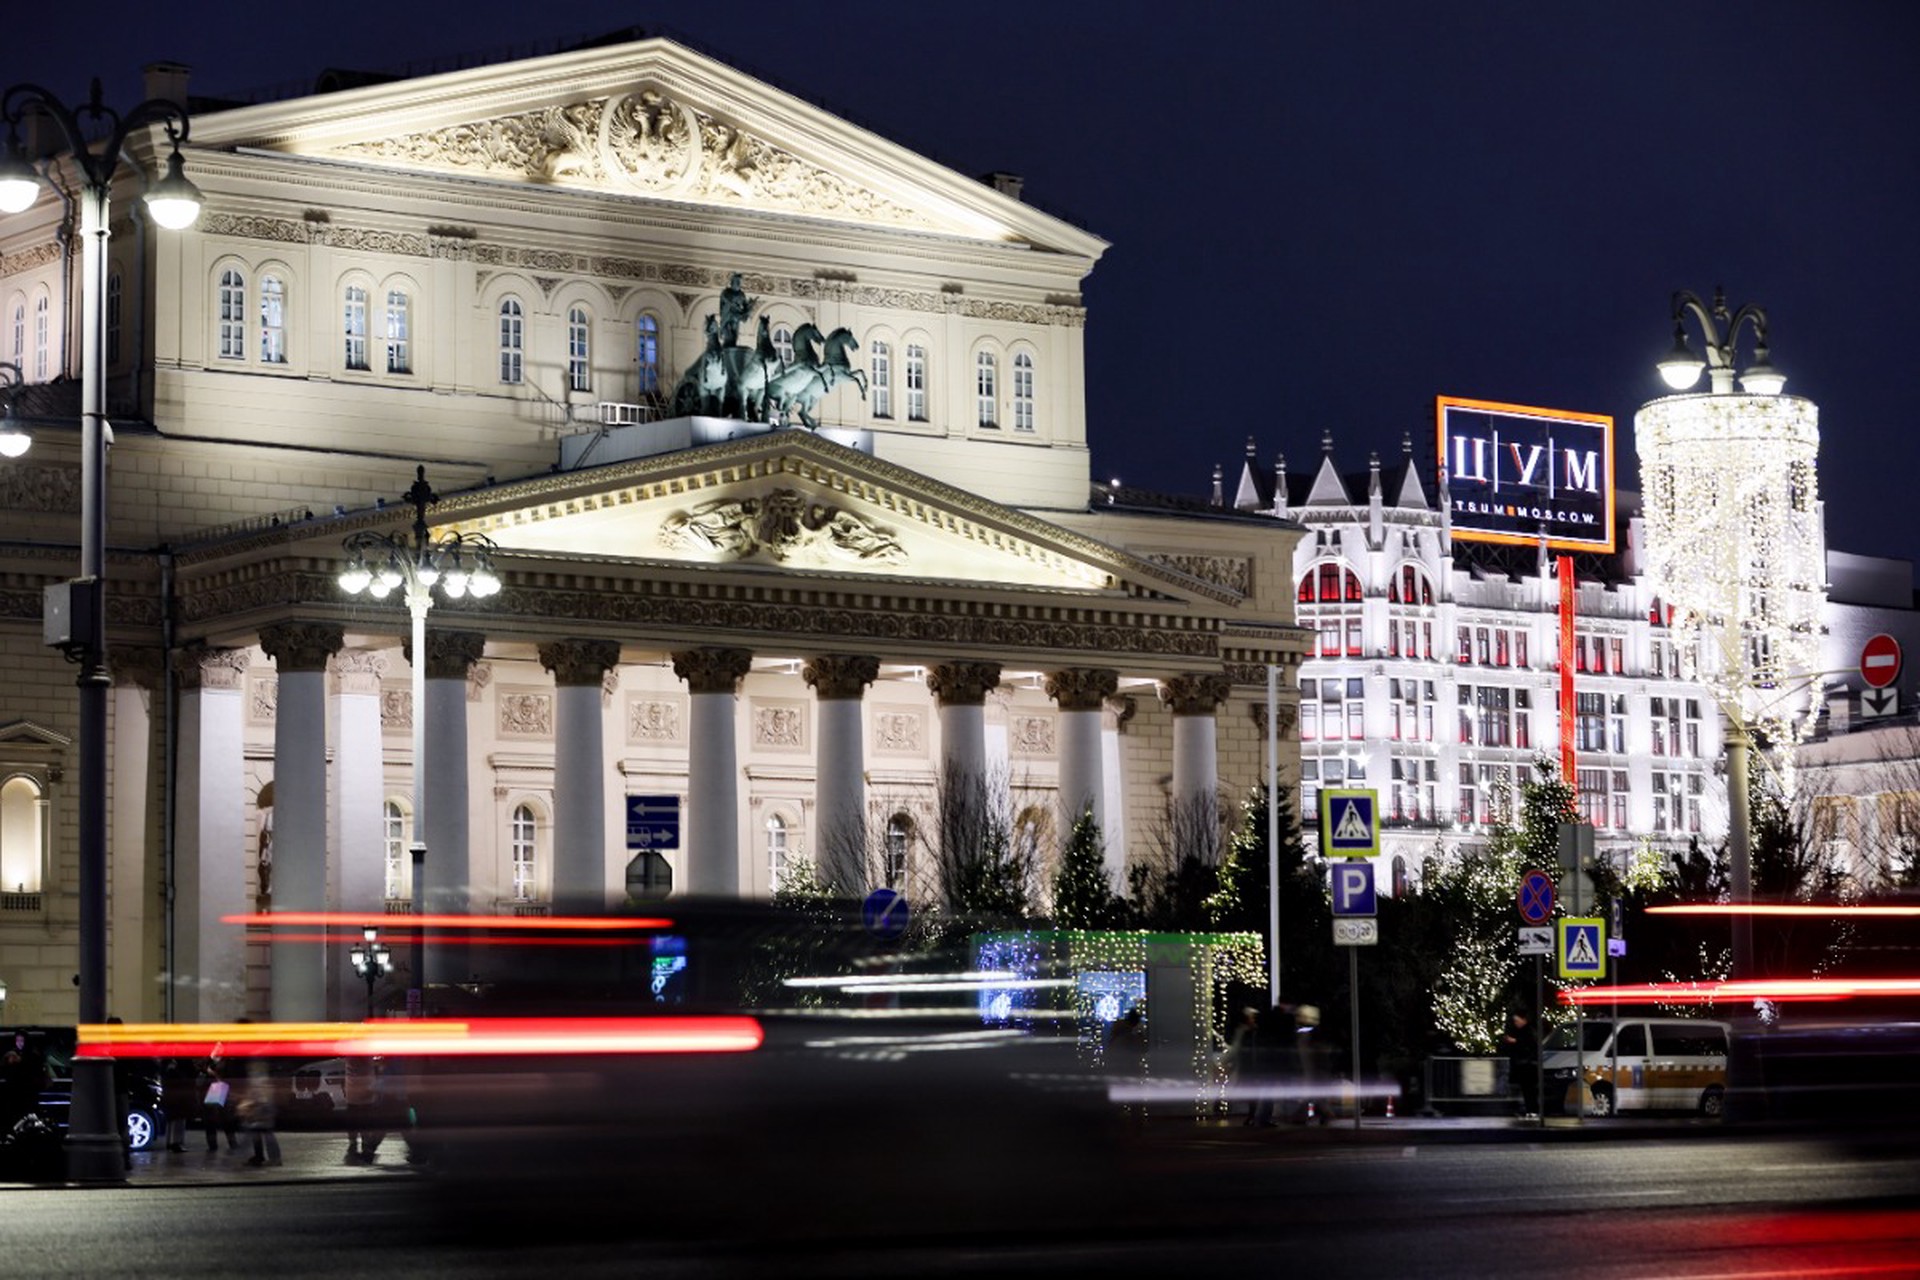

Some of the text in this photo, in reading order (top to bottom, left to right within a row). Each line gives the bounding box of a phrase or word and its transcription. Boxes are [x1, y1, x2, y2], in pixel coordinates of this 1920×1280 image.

[1456, 500, 1595, 524] TSUM MOSCOW
[1343, 869, 1367, 909] P
